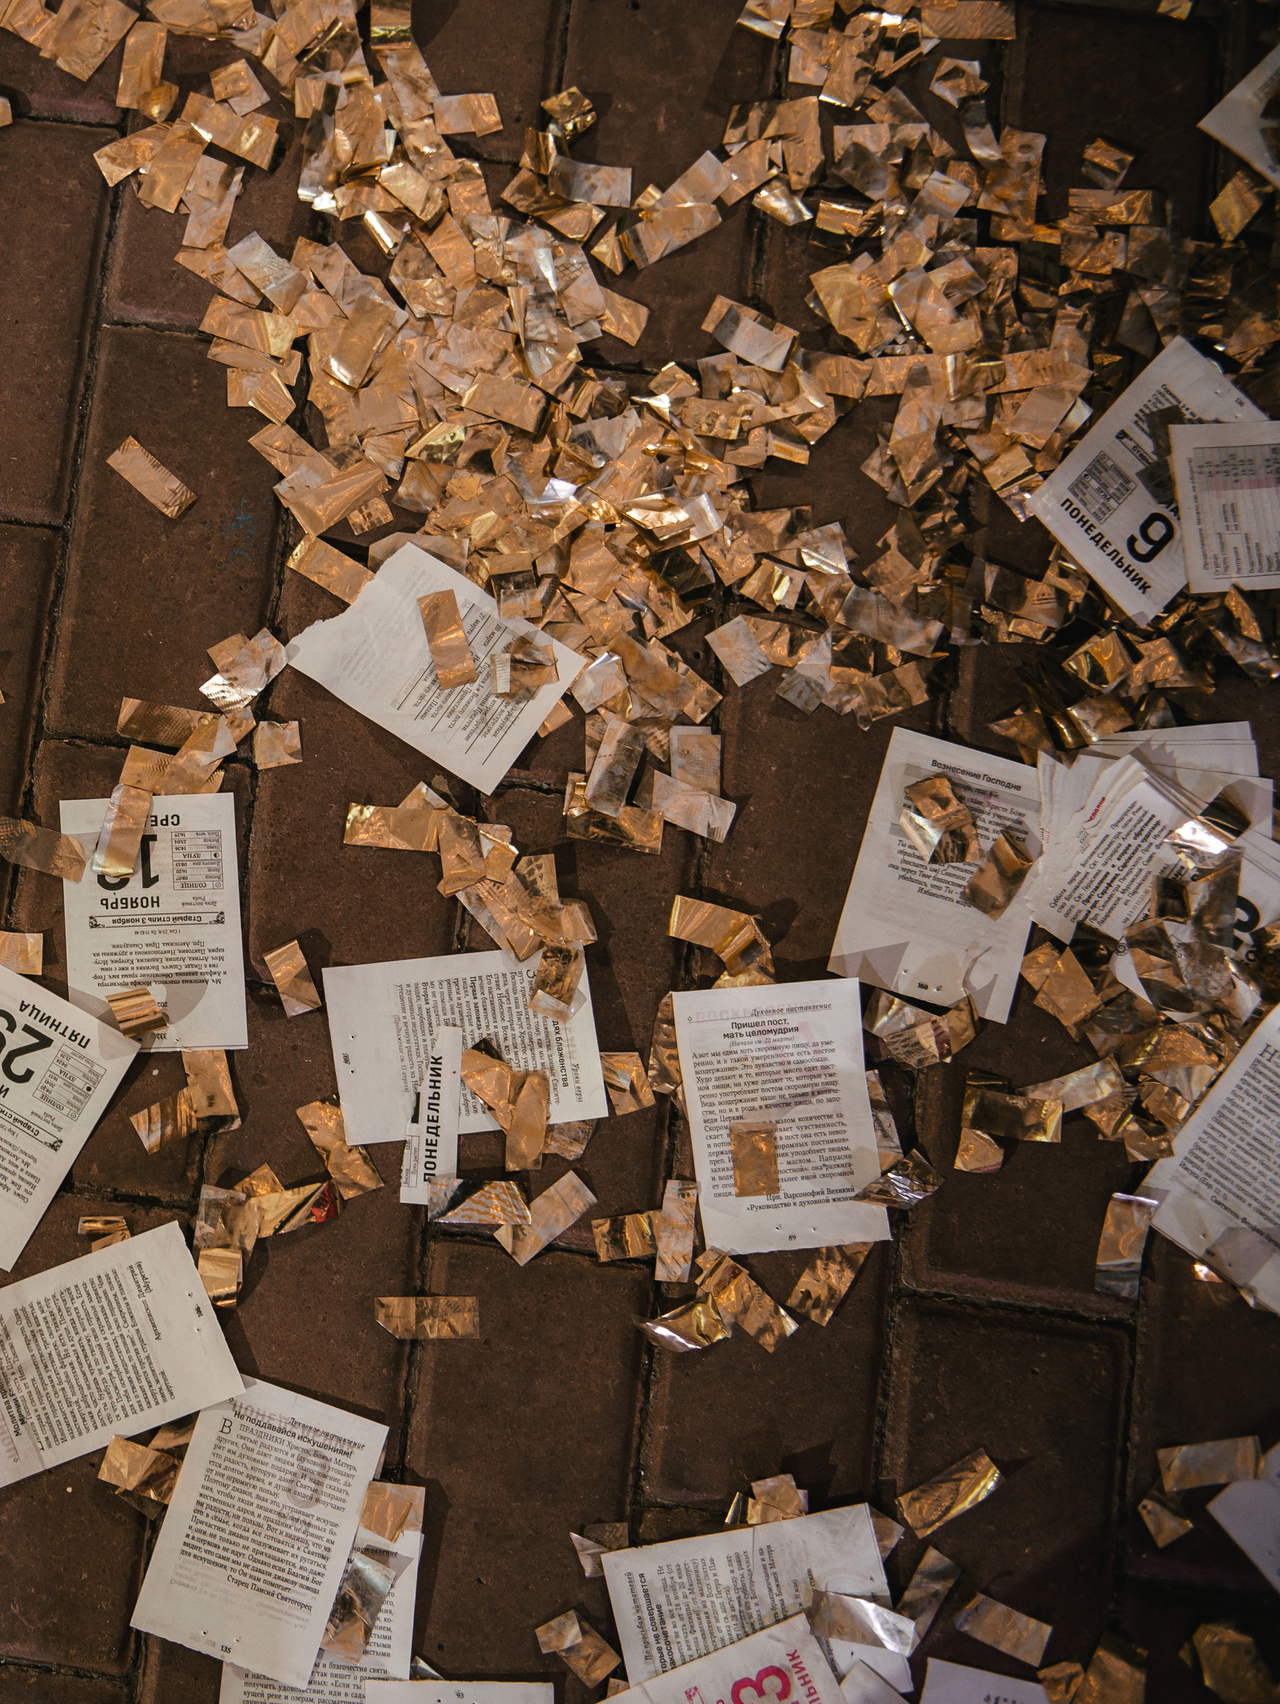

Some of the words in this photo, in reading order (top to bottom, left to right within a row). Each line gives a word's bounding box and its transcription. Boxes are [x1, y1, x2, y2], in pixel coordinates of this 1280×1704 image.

[1059, 497, 1151, 595] ПОНЕДЕЛЬНИК
[1125, 512, 1175, 564] 9
[465, 618, 480, 635] марта
[481, 630, 495, 647] марта
[931, 759, 982, 780] Вознесение
[981, 773, 1022, 792] Господне
[99, 895, 159, 909] НОЯБРЬ
[1081, 870, 1111, 906] Преставление
[111, 916, 140, 925] ноября
[170, 914, 201, 923] Старый
[420, 981, 429, 1005] Вторая
[468, 976, 477, 1000] Первая
[18, 999, 90, 1049] ПЯТНИЦА
[424, 1007, 433, 1037] заповедь
[472, 1001, 481, 1031] заповедь
[731, 1020, 766, 1030] Пришел
[767, 1018, 790, 1026] пост,
[745, 1026, 799, 1038] целомудрия
[58, 1067, 76, 1082] ЛУНА
[554, 1036, 568, 1088] блаженства
[39, 1092, 64, 1110] СОЛНЦЕ
[11, 1115, 40, 1136] Старый
[423, 1054, 443, 1183] ПОНЕДЕЛЬНИК
[764, 1190, 781, 1202] Прп.
[783, 1188, 825, 1200] Варсонофий
[825, 1184, 856, 1195] Великий
[134, 1260, 153, 1293] (Муретов)
[3, 1398, 22, 1436] Молитва
[245, 1415, 297, 1439] поддавайся
[296, 1434, 353, 1458] искушениям!
[226, 1574, 250, 1589] Старец
[250, 1582, 275, 1598] Паисий
[275, 1592, 312, 1612] Святогорец
[638, 1571, 659, 1632] совершается
[220, 1645, 231, 1654] 135
[655, 1603, 677, 1669] акосочетание
[328, 1661, 368, 1672] благочестия
[731, 1665, 800, 1704] 3
